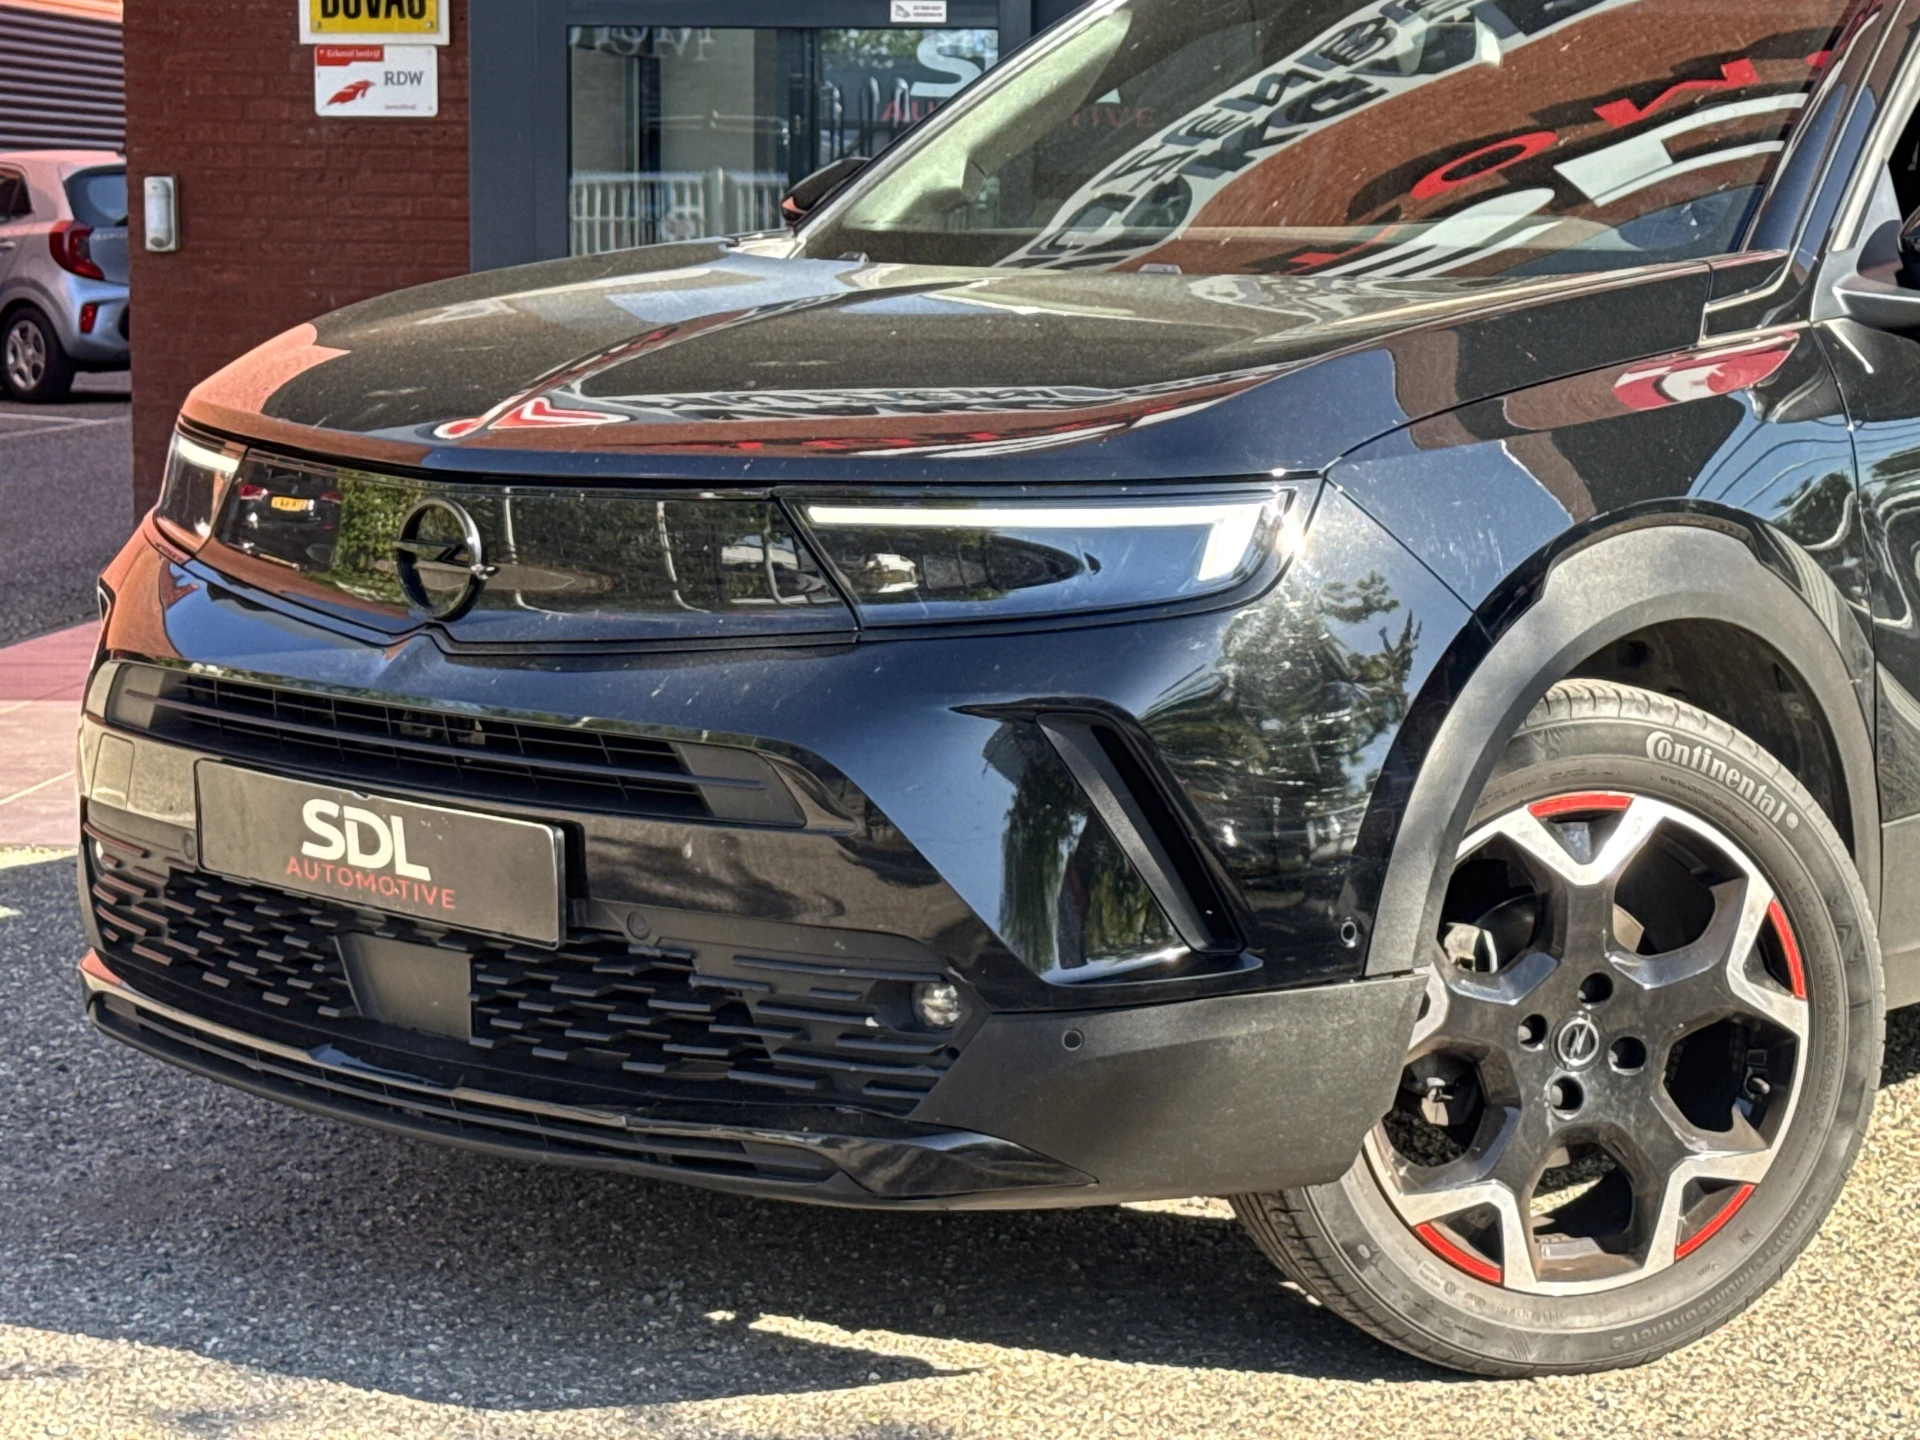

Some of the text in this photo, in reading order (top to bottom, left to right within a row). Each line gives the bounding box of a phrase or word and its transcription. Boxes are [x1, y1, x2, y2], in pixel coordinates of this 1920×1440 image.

[384, 71, 424, 86] RDW
[1646, 731, 1787, 824] Continental
[301, 799, 431, 881] SDL
[286, 857, 455, 909] AUTOMOTIVE
